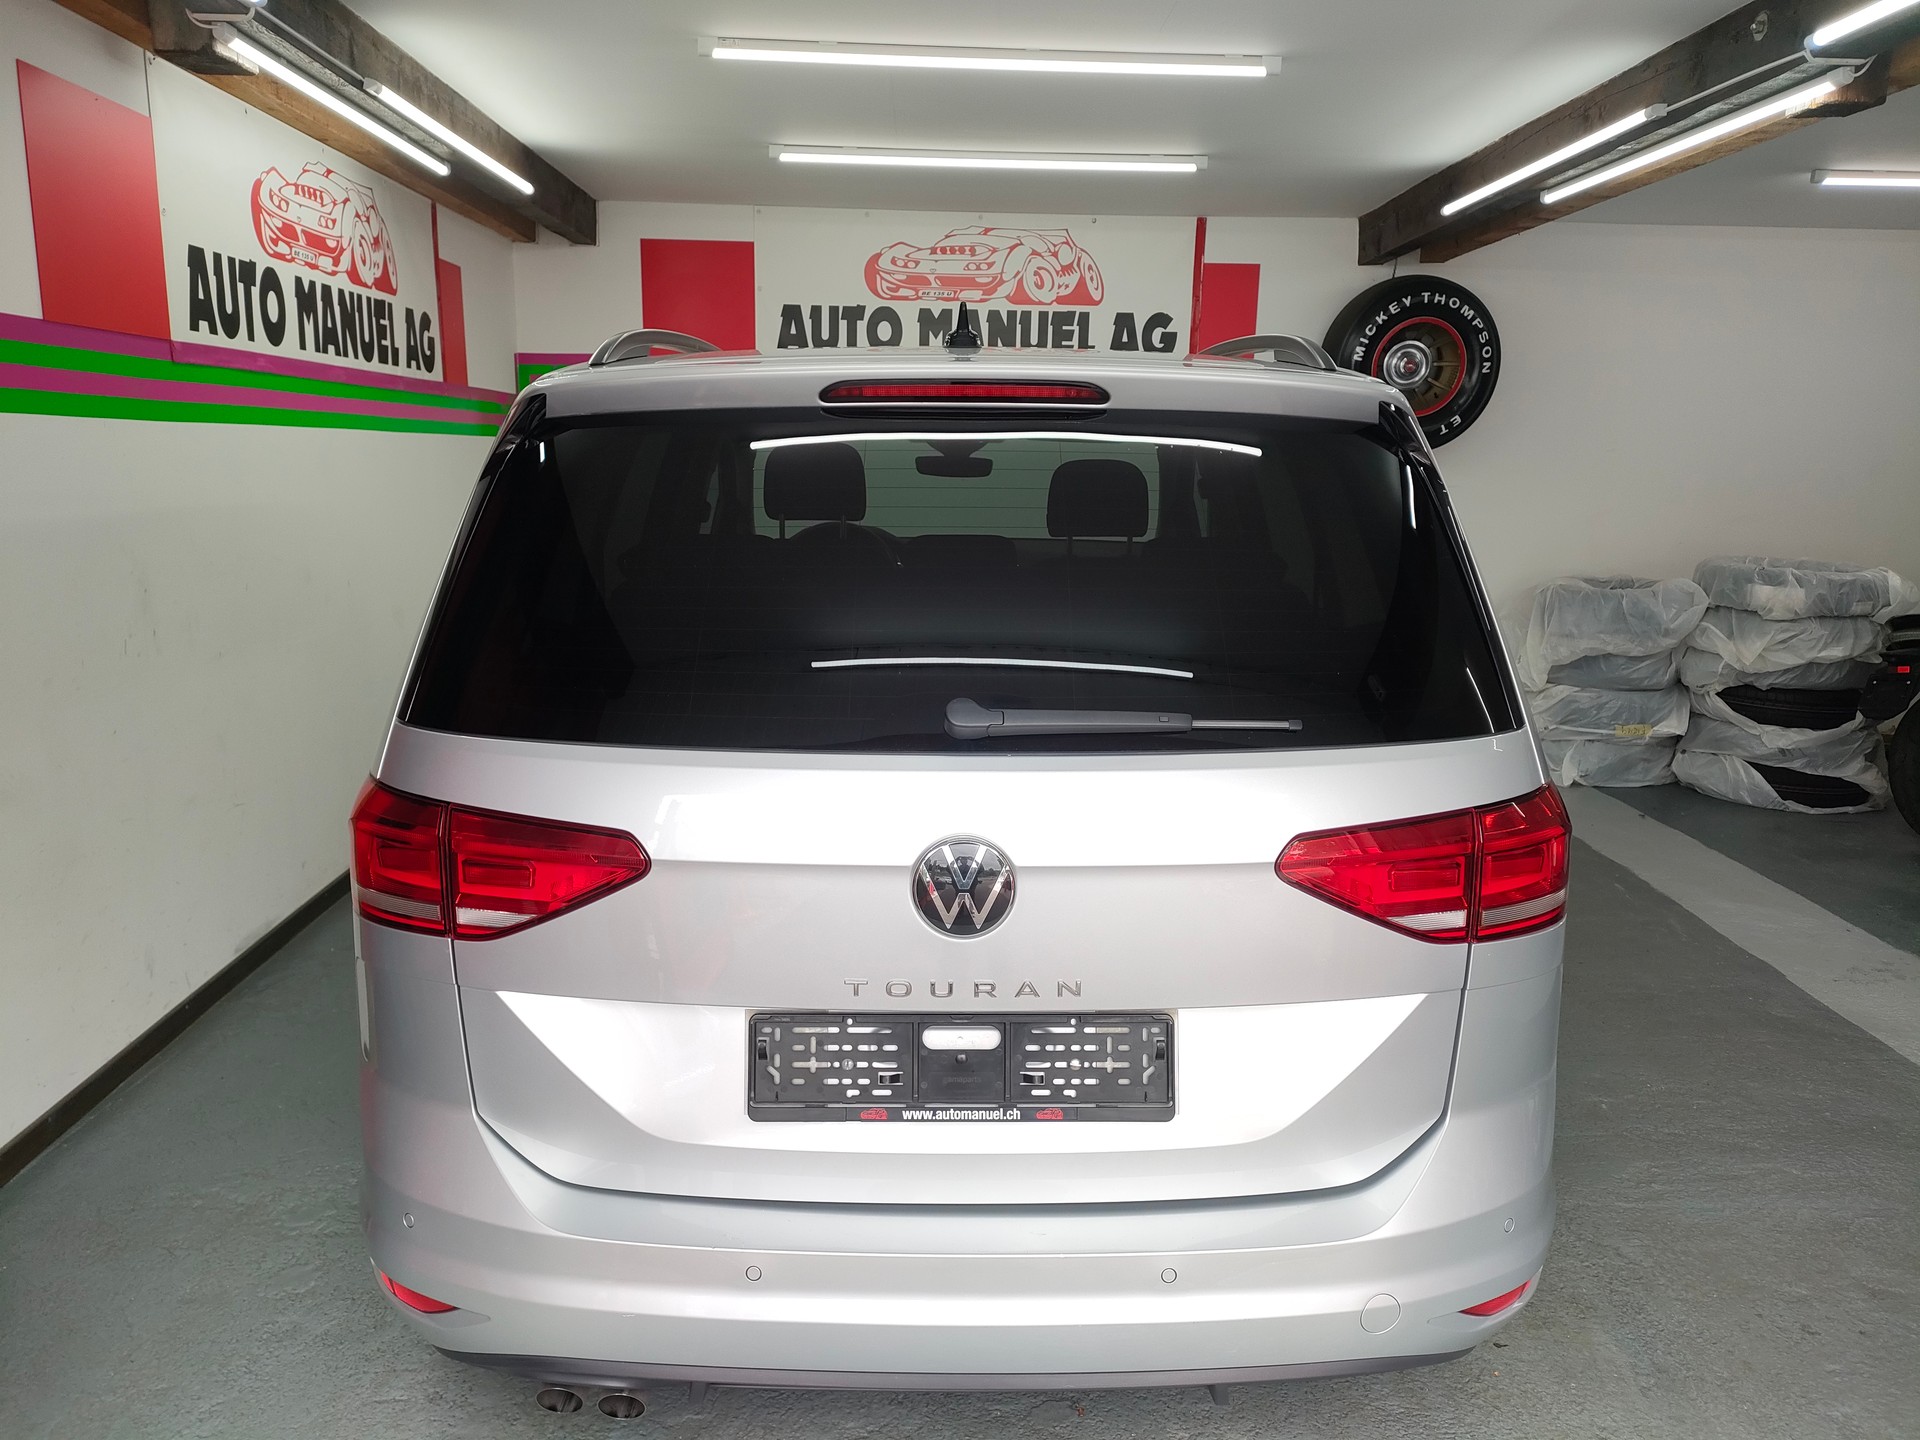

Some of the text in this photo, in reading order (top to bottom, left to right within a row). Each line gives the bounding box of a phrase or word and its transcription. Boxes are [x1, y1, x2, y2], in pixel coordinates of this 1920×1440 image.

[187, 244, 435, 374] AUTO MANUEL AG
[777, 304, 903, 349] AUTO
[1110, 312, 1178, 352] AG
[1353, 291, 1492, 374] MICKEY THOMPSON
[1439, 414, 1463, 436] ET
[918, 843, 1010, 930] VW
[843, 978, 1082, 998] TOURAN
[902, 1107, 1021, 1121] www.automanuel.ch
